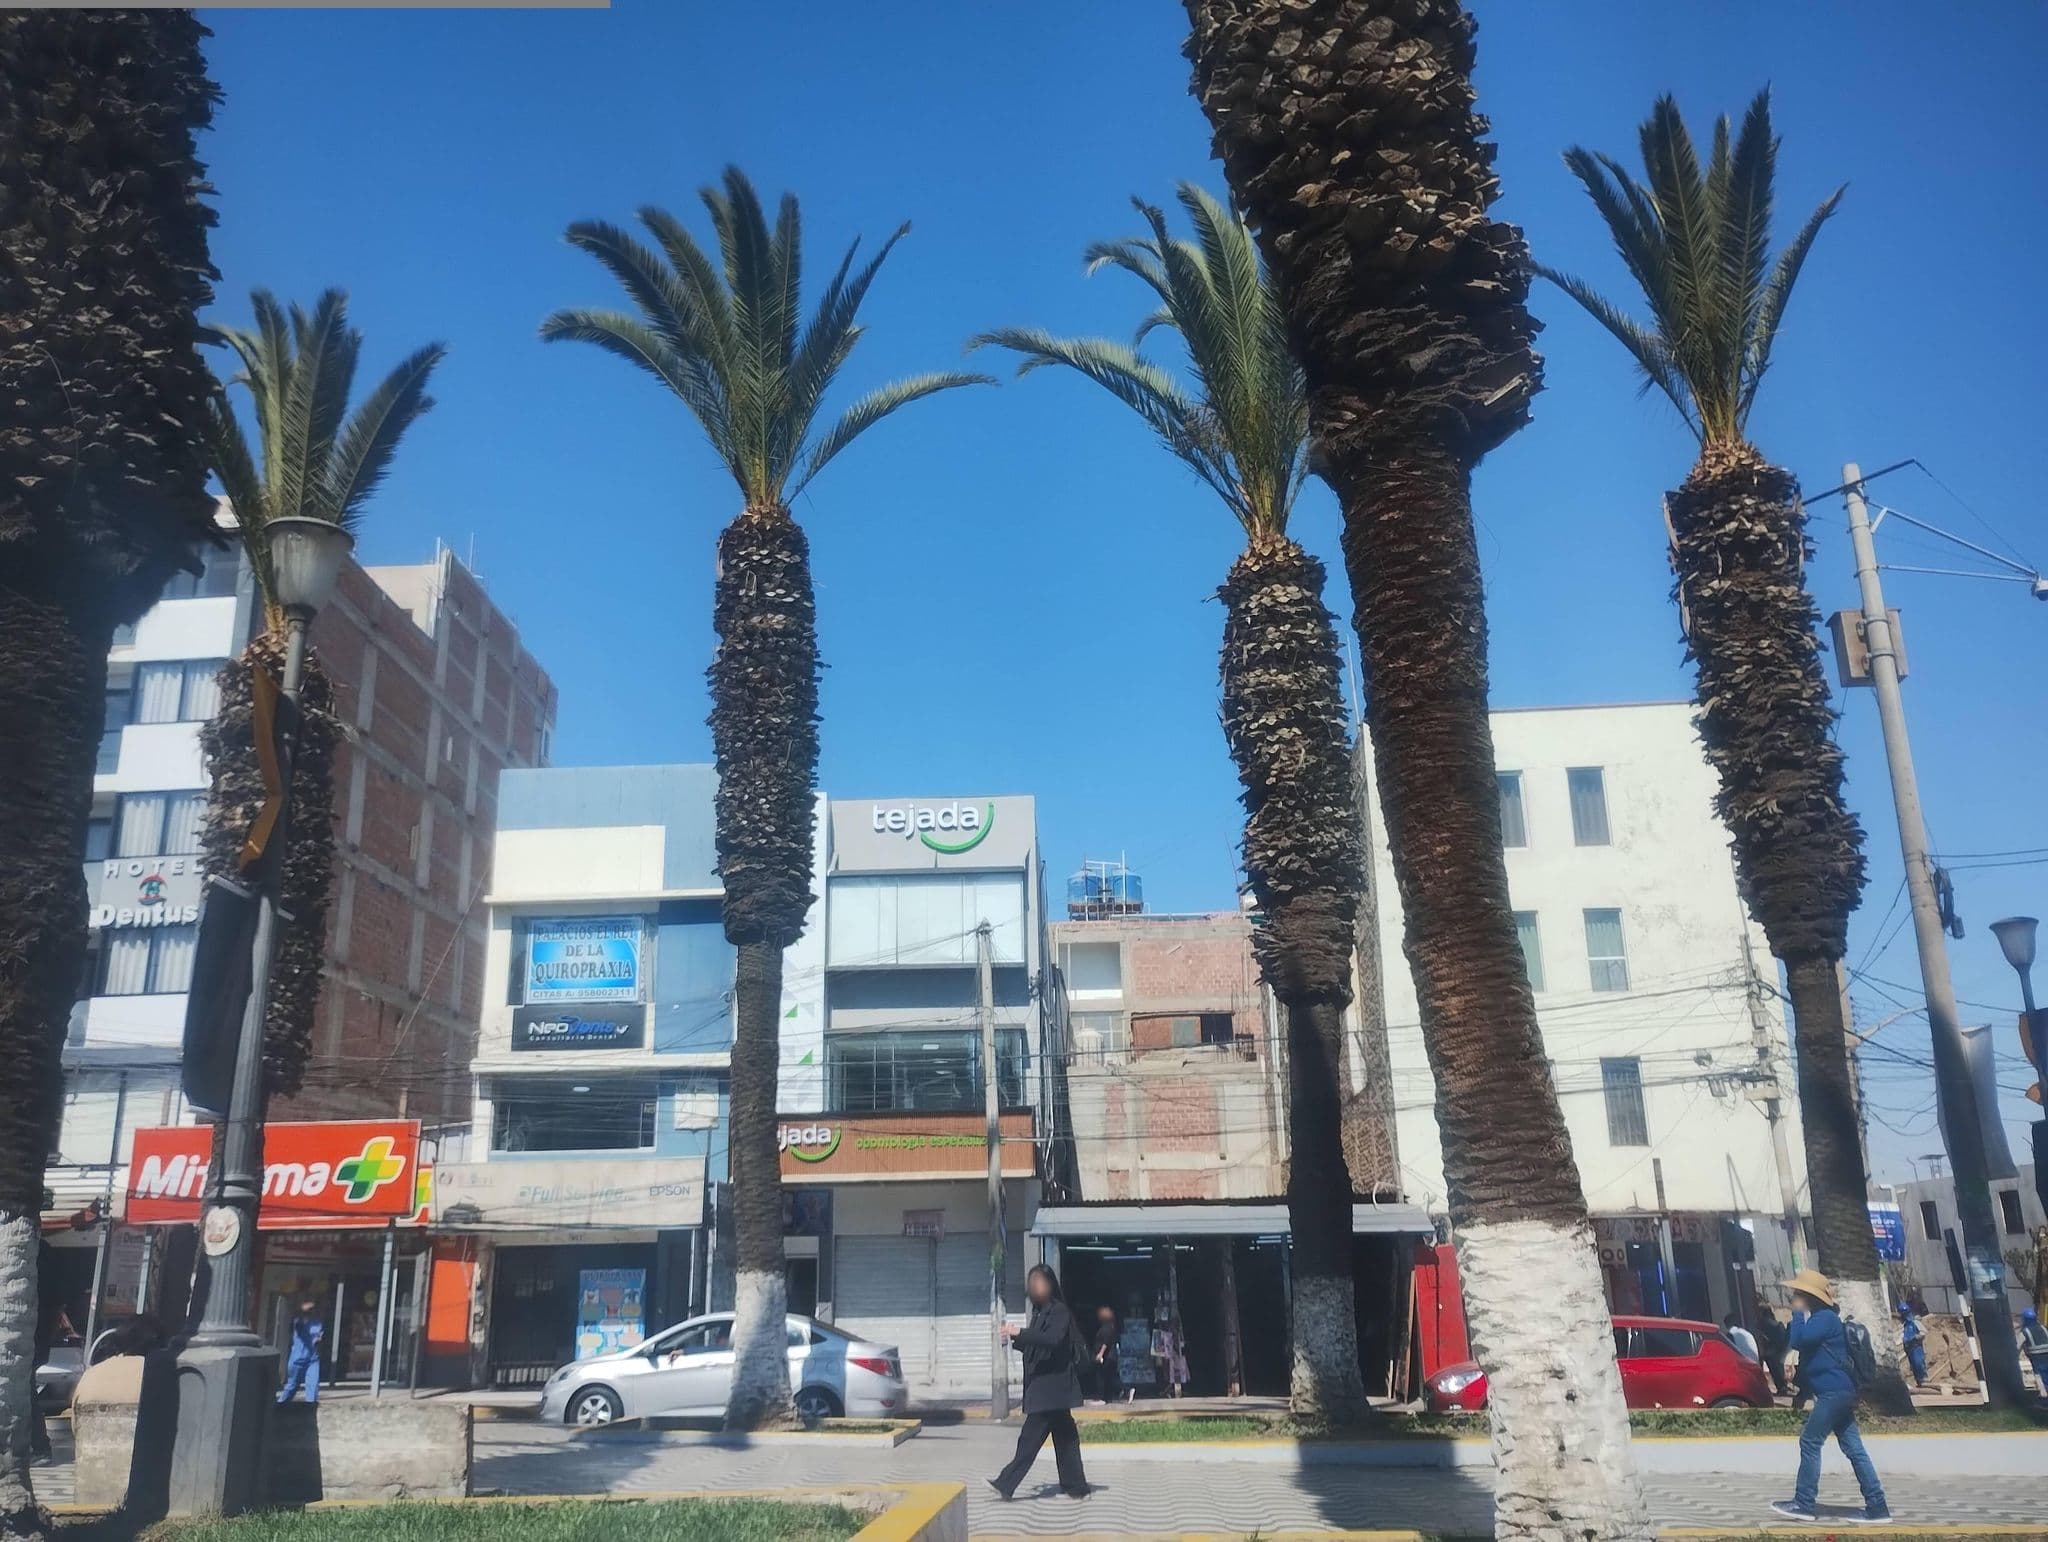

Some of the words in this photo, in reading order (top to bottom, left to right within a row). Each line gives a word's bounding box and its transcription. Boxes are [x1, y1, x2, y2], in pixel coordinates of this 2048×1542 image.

[873, 801, 980, 840] tejada
[103, 859, 205, 879] HOTEL
[566, 944, 584, 957] DE
[587, 943, 605, 956] LA
[535, 960, 633, 984] QUIROPRAXIA
[533, 990, 562, 998] CITAS
[649, 1183, 691, 1197] EPSON
